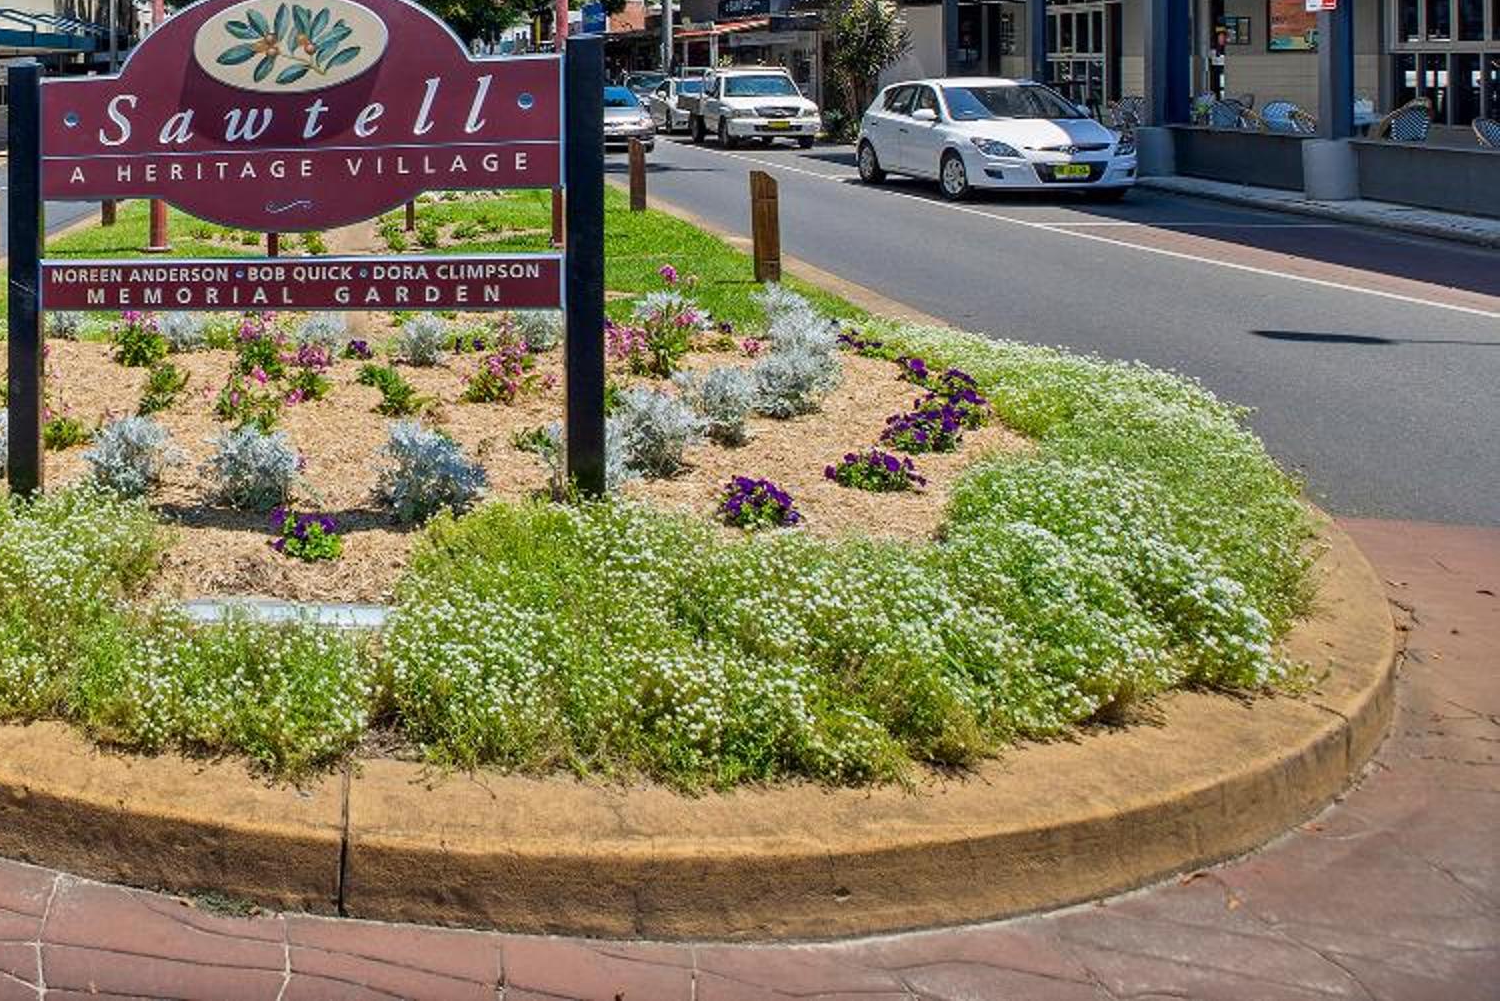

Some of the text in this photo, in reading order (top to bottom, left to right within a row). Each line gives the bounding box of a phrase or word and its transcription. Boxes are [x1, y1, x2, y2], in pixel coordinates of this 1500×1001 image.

[99, 75, 493, 146] Sawtell
[70, 153, 528, 183] A HERITAGE VILLAGE
[51, 264, 540, 283] NOREEN ANDERSON BOB QUICK DORA CLIMPSON
[87, 285, 500, 304] MEMORIAL GARDEN
